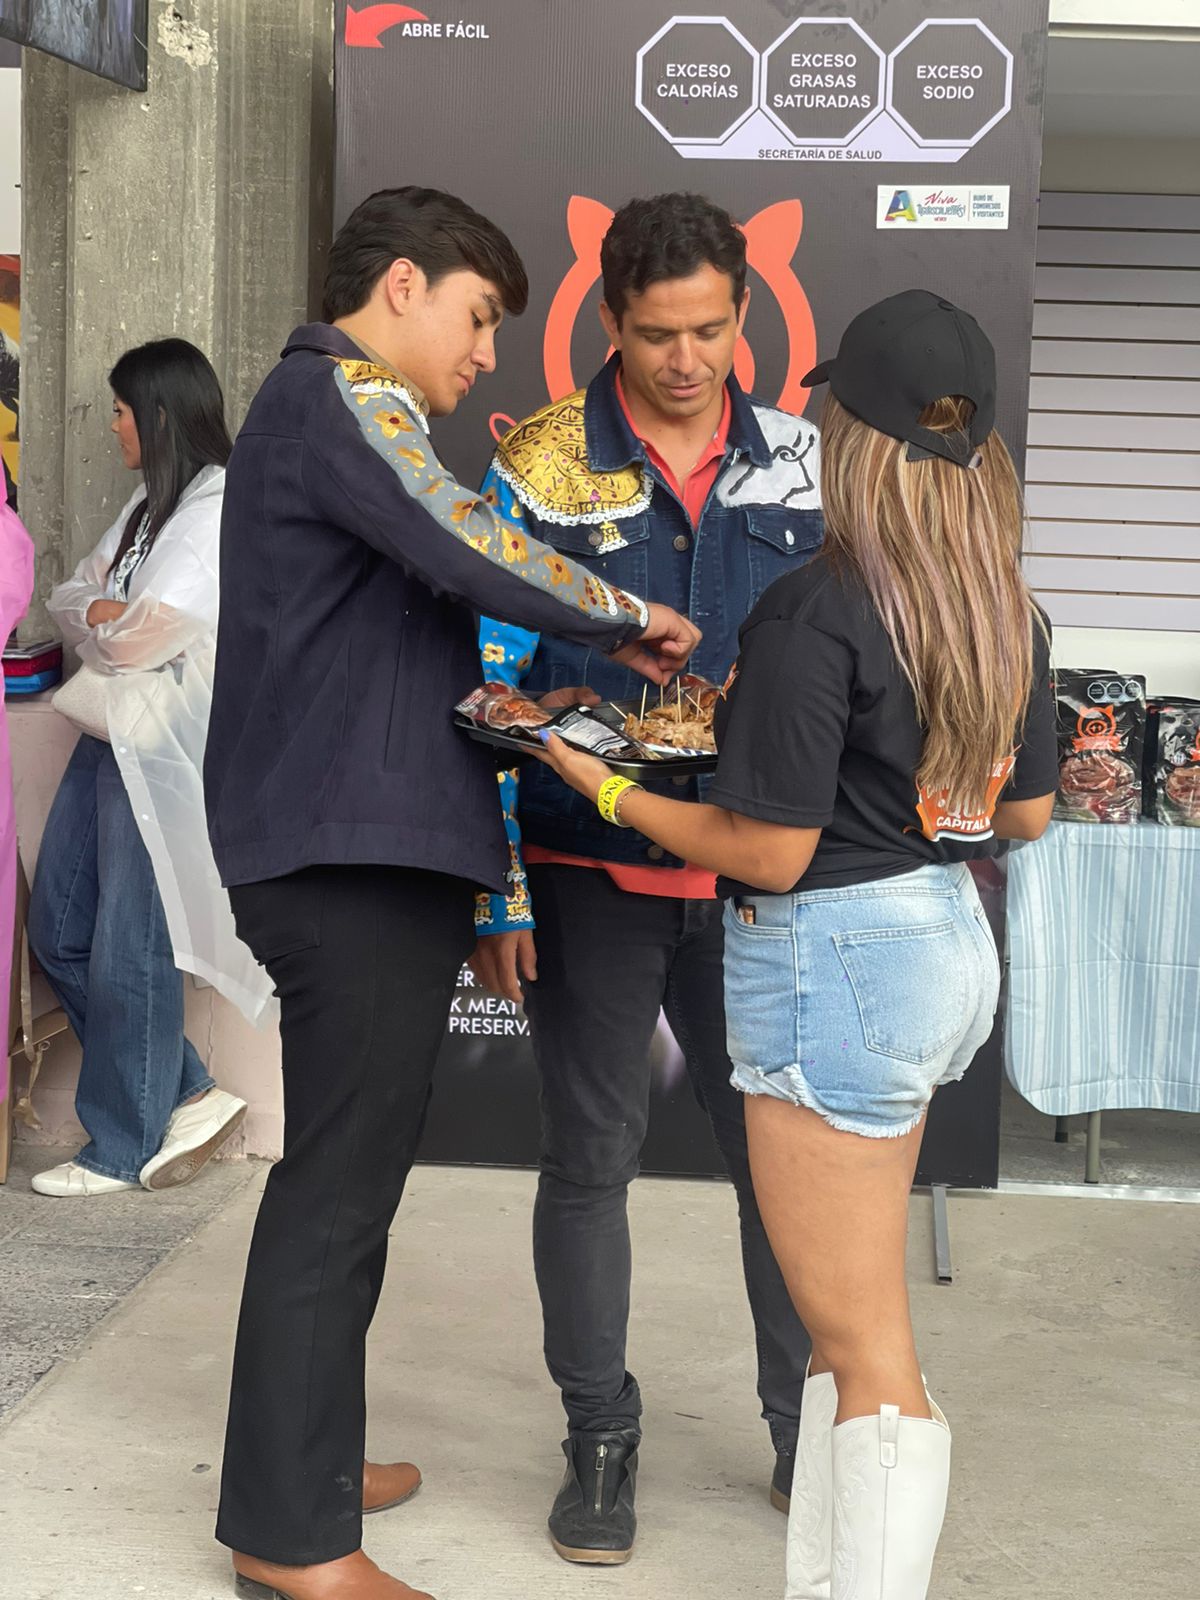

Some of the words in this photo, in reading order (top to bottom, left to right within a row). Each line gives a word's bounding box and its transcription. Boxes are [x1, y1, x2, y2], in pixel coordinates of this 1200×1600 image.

[402, 23, 442, 37] ABRE
[446, 20, 490, 38] FÁCIL
[791, 54, 857, 67] EXCESO
[666, 64, 731, 78] EXCESO
[916, 65, 983, 79] EXCESO
[789, 74, 857, 88] GRASAS
[657, 81, 738, 98] CALORÍAS
[923, 85, 974, 99] SODIO
[773, 94, 871, 108] SATURADAS
[758, 148, 826, 159] SECRETARÍA
[828, 149, 842, 159] DE
[846, 150, 883, 159] SALUD
[936, 816, 985, 831] CAPITAL
[467, 998, 516, 1016] MEAT
[449, 1017, 530, 1036] PRESERV
